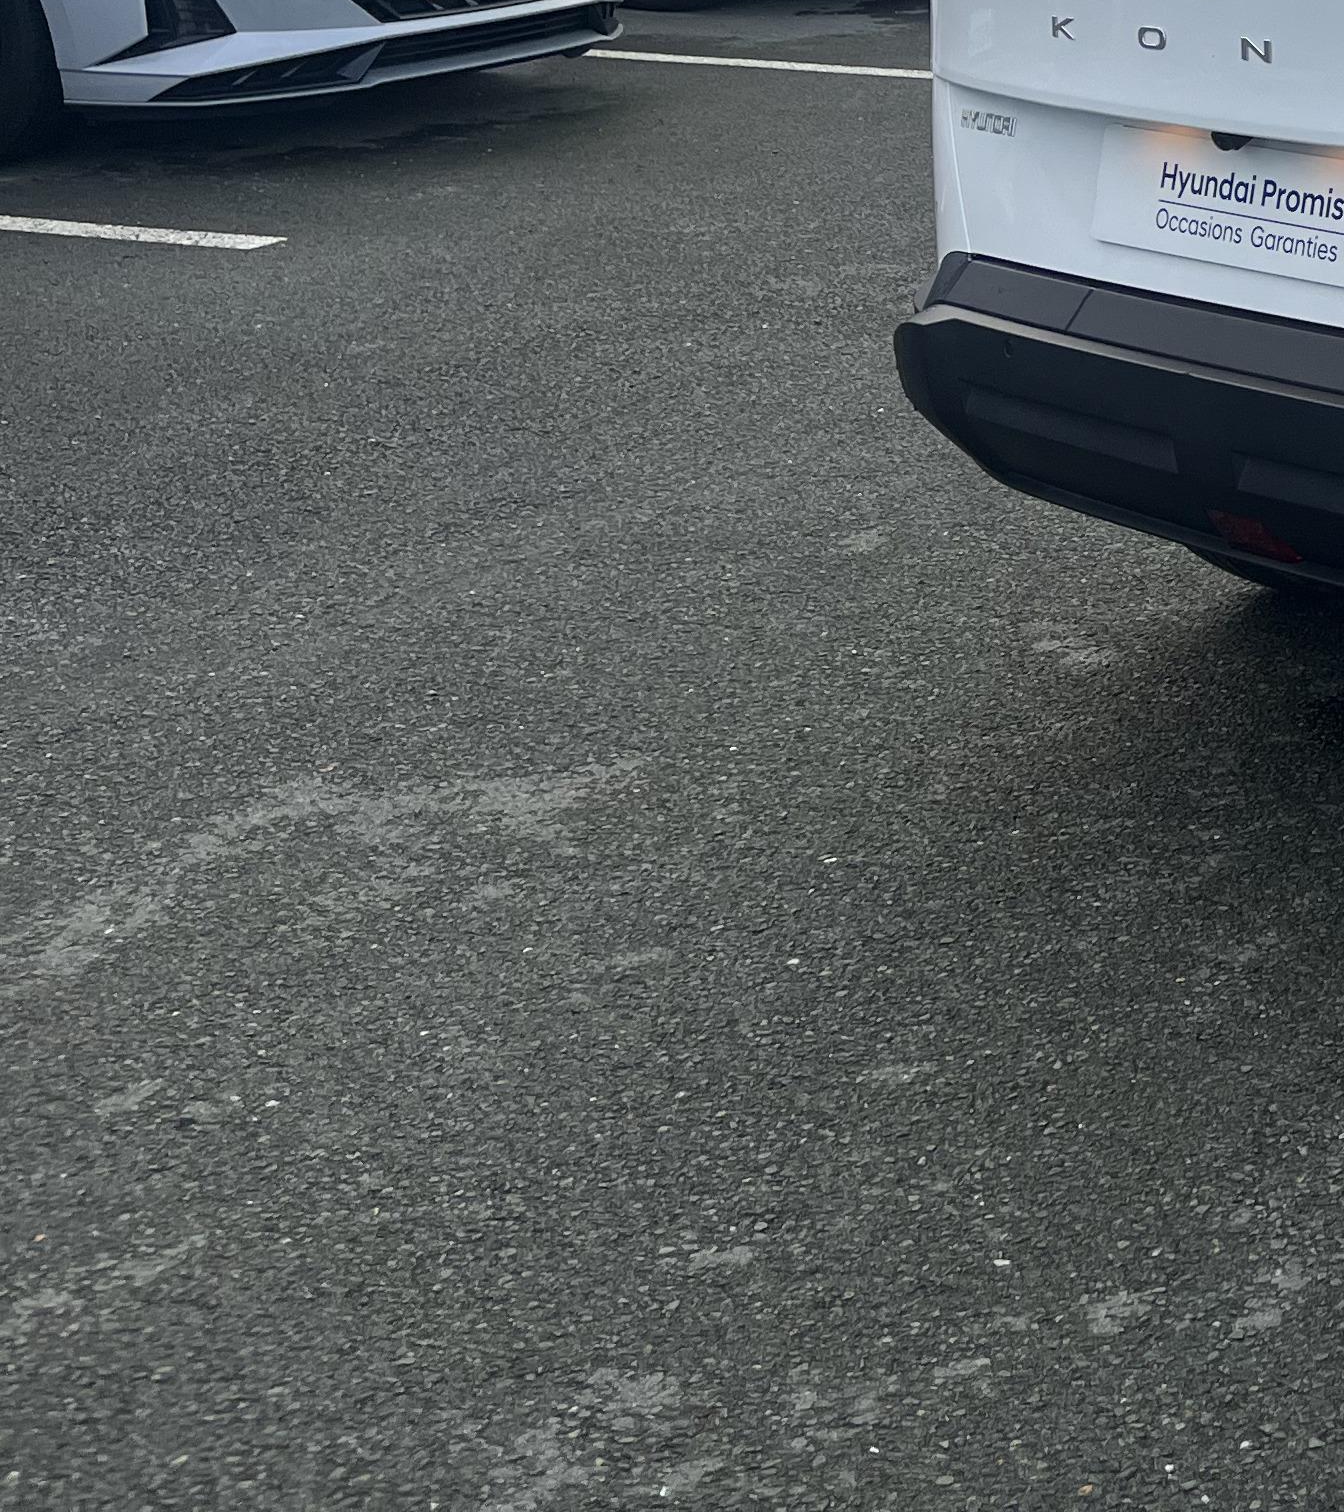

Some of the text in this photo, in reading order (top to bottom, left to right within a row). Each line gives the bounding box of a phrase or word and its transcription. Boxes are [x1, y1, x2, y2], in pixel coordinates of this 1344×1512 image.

[1159, 161, 1257, 205] Hyundai
[1155, 208, 1338, 263] Occasions Garanties
